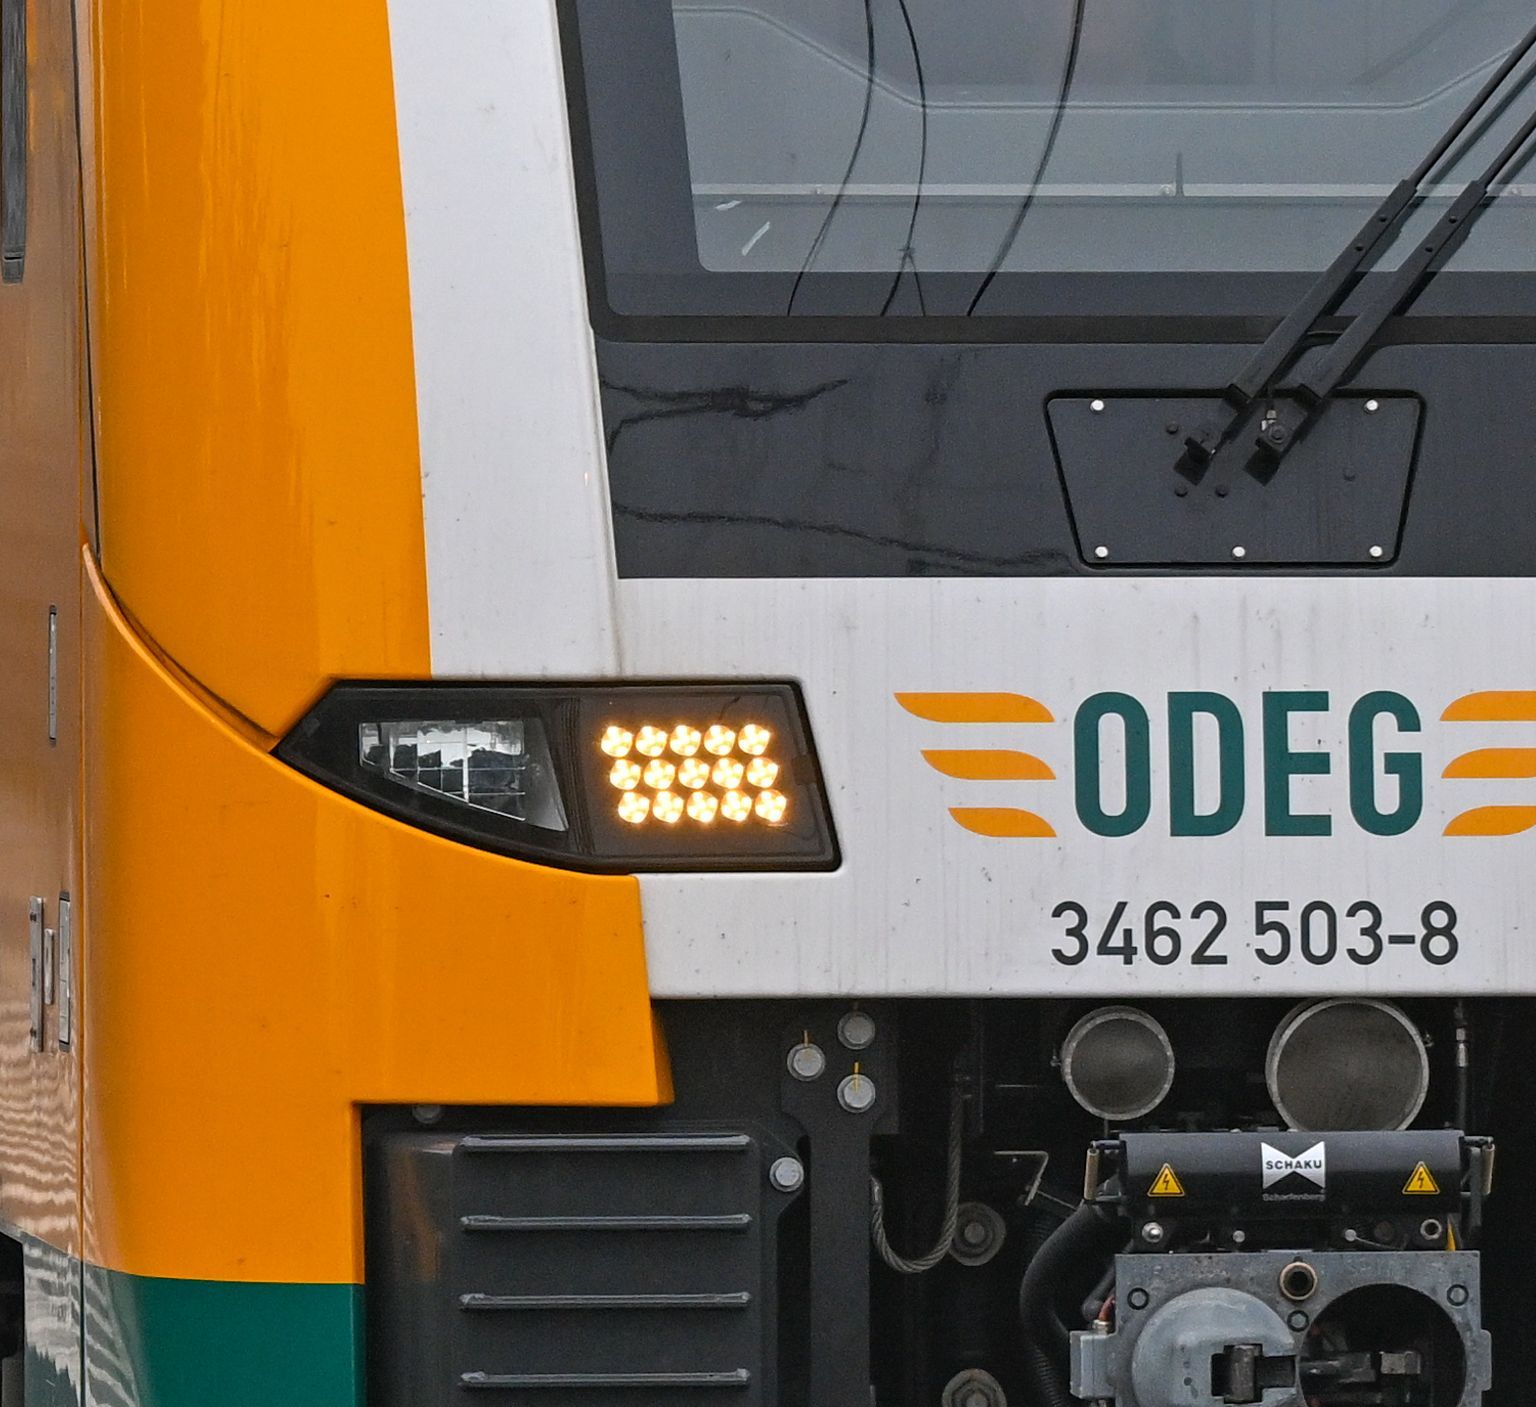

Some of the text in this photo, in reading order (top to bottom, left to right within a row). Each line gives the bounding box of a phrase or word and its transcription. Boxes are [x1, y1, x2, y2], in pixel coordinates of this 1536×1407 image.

[1073, 690, 1424, 838] ODEG
[1051, 899, 1460, 967] 3462 503-8
[1266, 1159, 1322, 1170] SCHAKU
